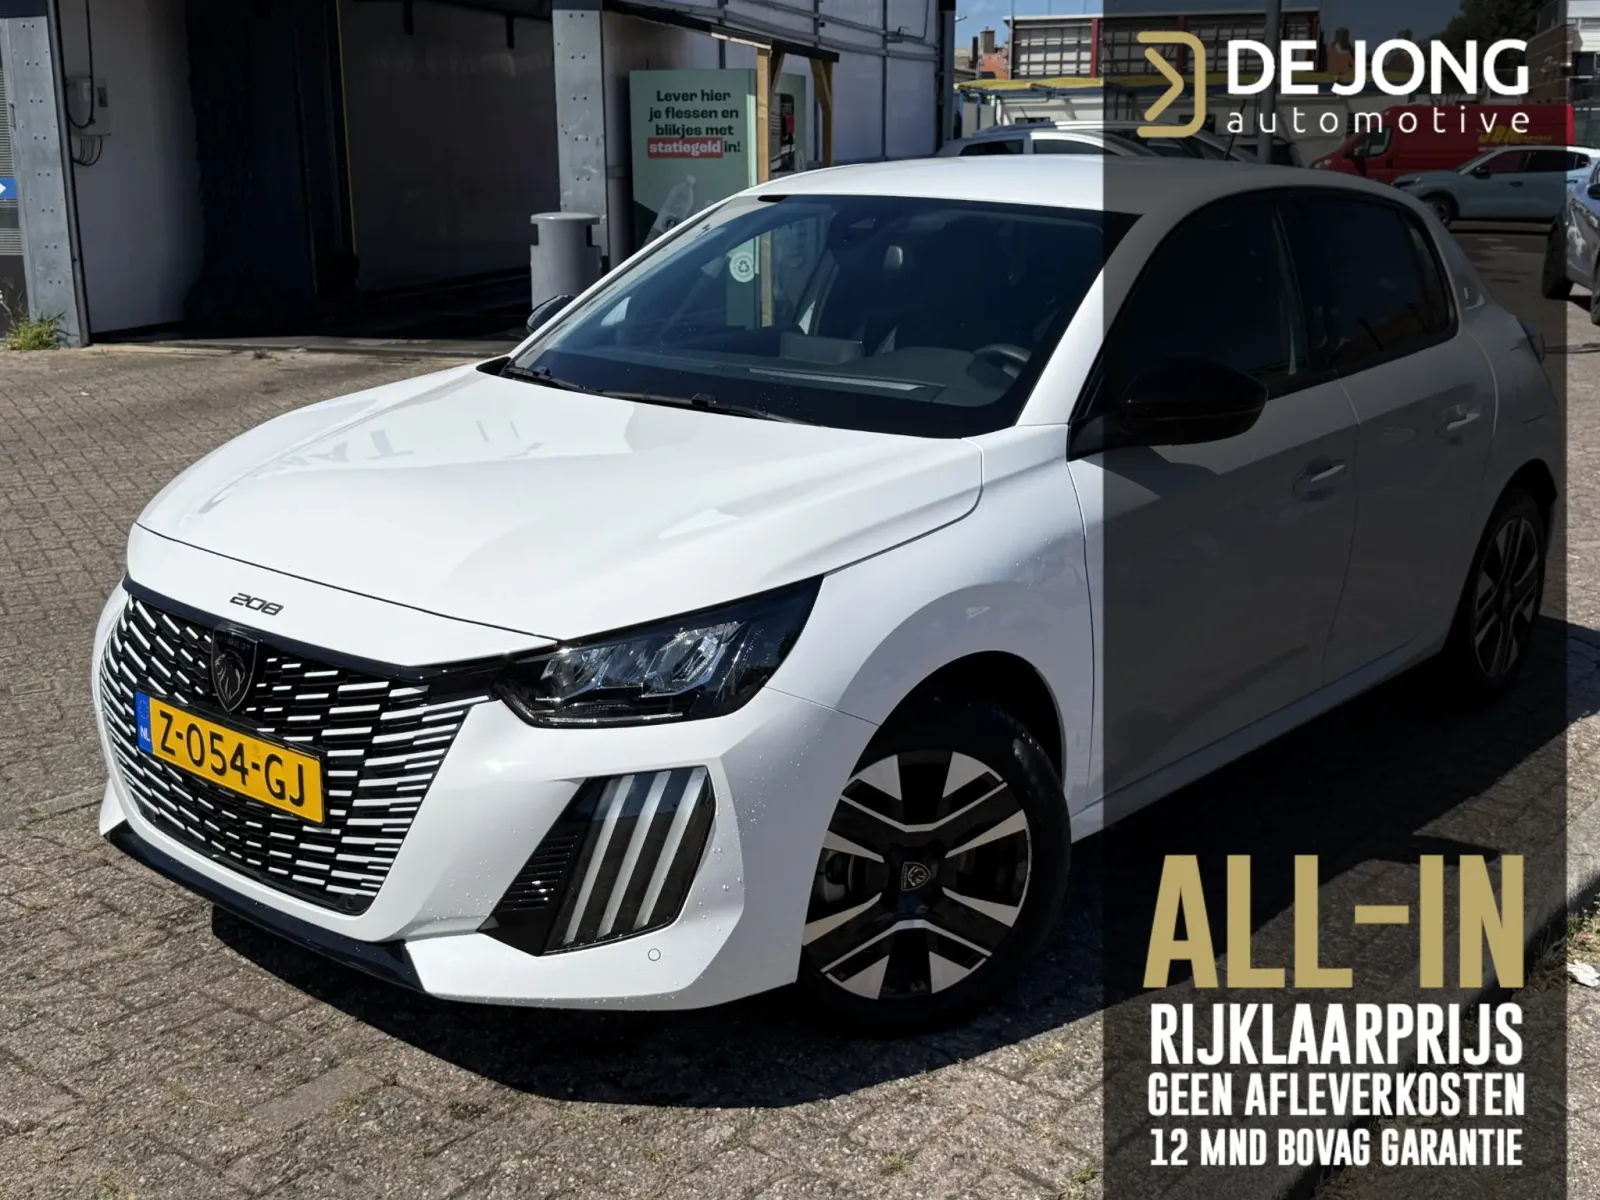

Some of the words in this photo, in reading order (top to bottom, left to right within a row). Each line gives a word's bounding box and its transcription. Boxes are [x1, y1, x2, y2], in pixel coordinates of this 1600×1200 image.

[656, 90, 698, 102] Lever
[700, 89, 731, 101] hier
[648, 107, 662, 122] je
[665, 106, 718, 119] flessen
[721, 108, 739, 119] en
[655, 124, 702, 138] blikjes
[705, 125, 734, 136] met
[649, 140, 721, 156] statiegeld
[724, 141, 741, 152] in!
[229, 592, 284, 616] 208
[140, 725, 151, 742] NL
[159, 709, 305, 808] Z-054-GJ
